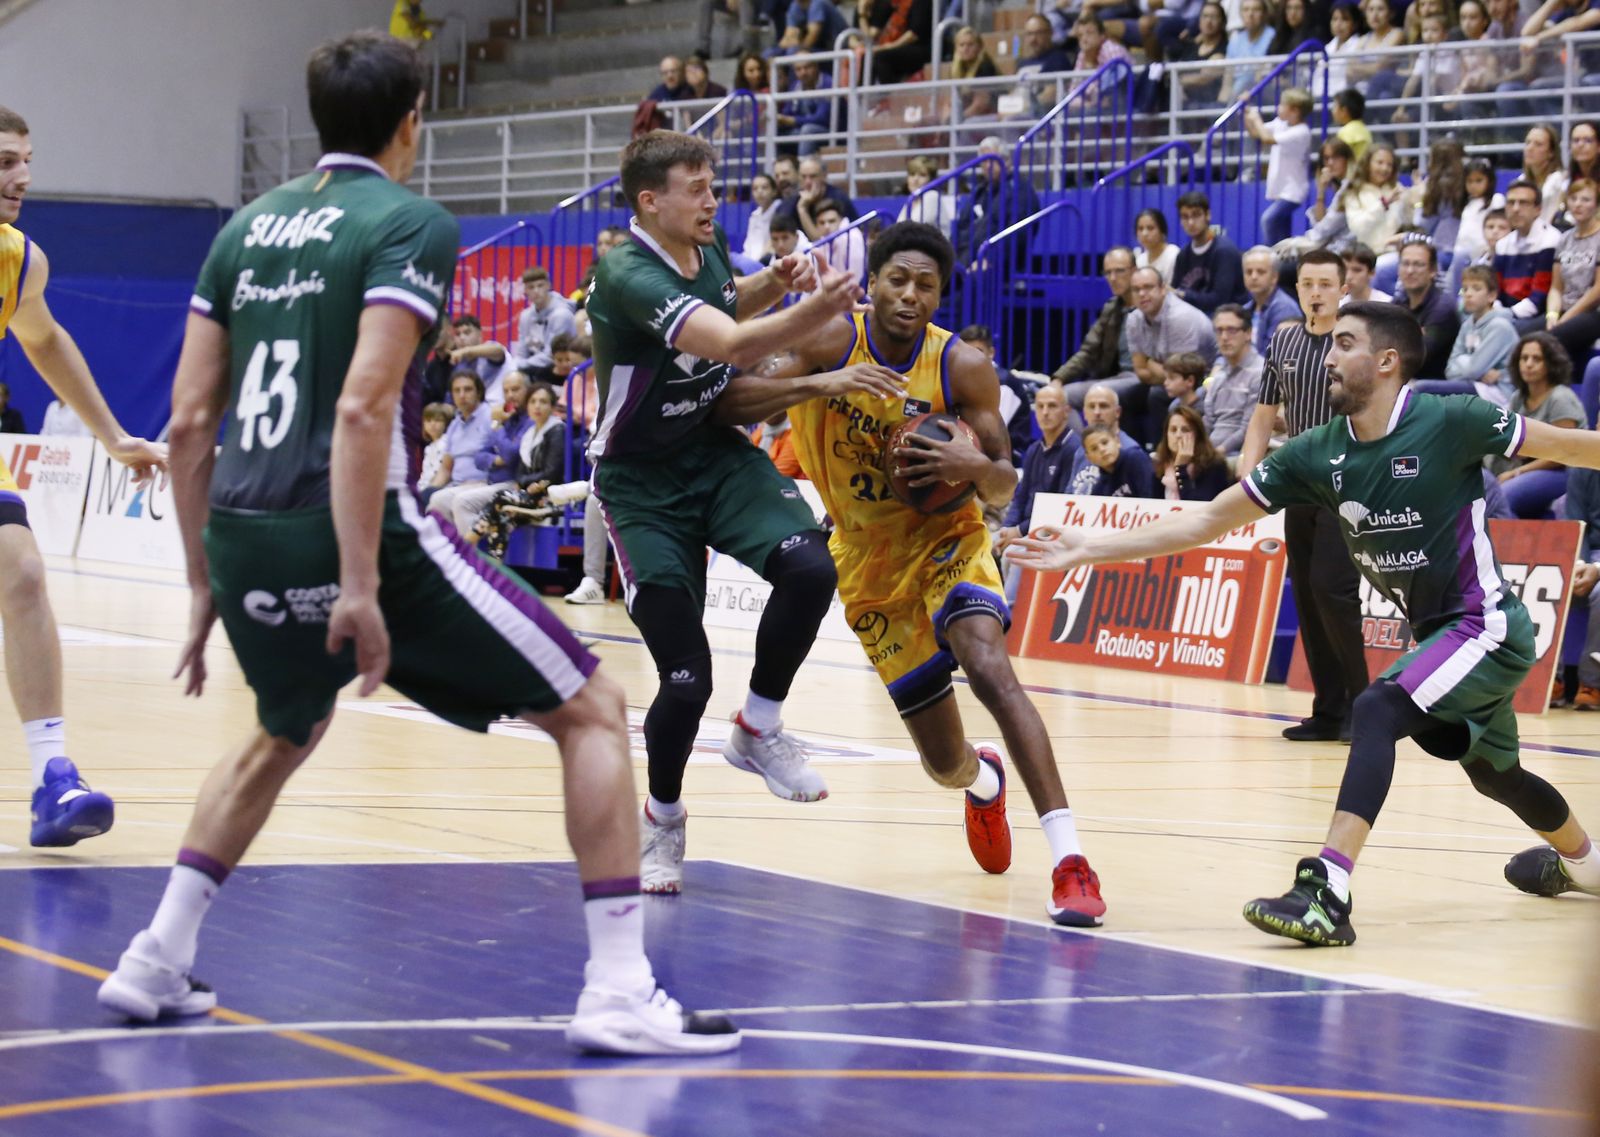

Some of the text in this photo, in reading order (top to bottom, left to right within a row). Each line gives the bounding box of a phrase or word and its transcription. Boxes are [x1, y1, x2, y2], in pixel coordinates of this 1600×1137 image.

[236, 339, 300, 452] 43
[1062, 501, 1084, 527] Tu
[1366, 506, 1422, 527] Unicaja
[1375, 550, 1428, 568] MÁLAGA
[1089, 555, 1240, 645] publinilo
[1094, 629, 1226, 668] Rotulos y Vinilos
[1362, 616, 1404, 650] DEL
